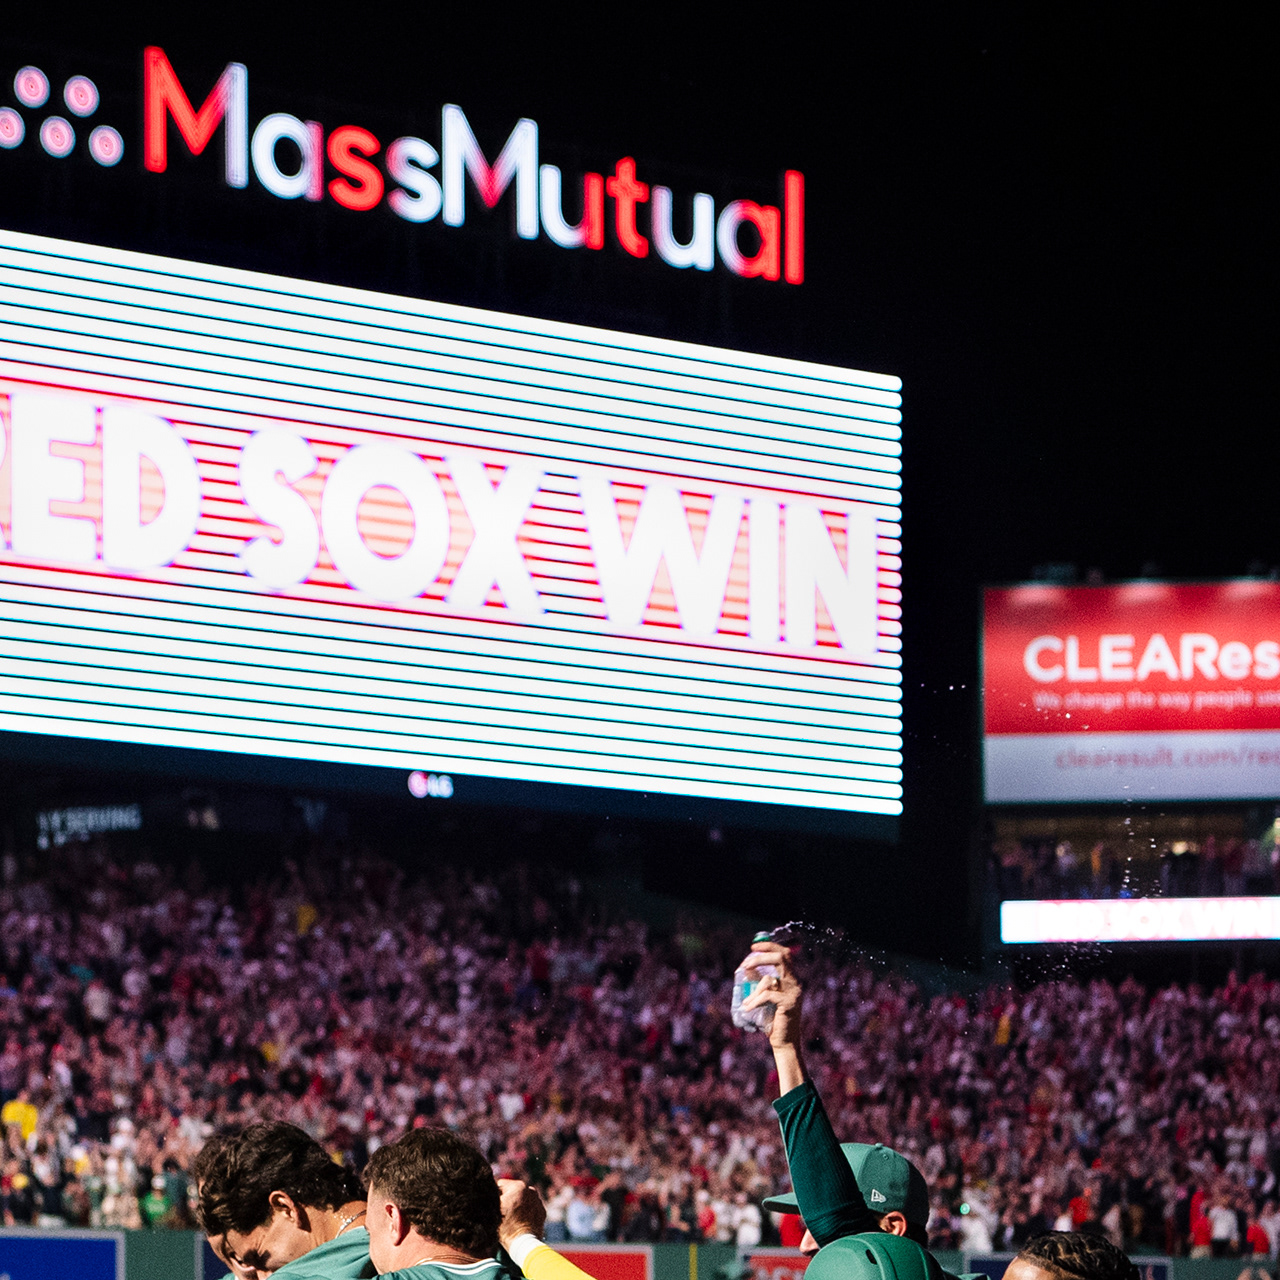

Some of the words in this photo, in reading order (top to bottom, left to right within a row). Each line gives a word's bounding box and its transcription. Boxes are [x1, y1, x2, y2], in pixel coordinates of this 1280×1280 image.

[143, 45, 805, 284] MassMutual
[238, 427, 547, 614] SOX
[577, 472, 880, 654] WIN
